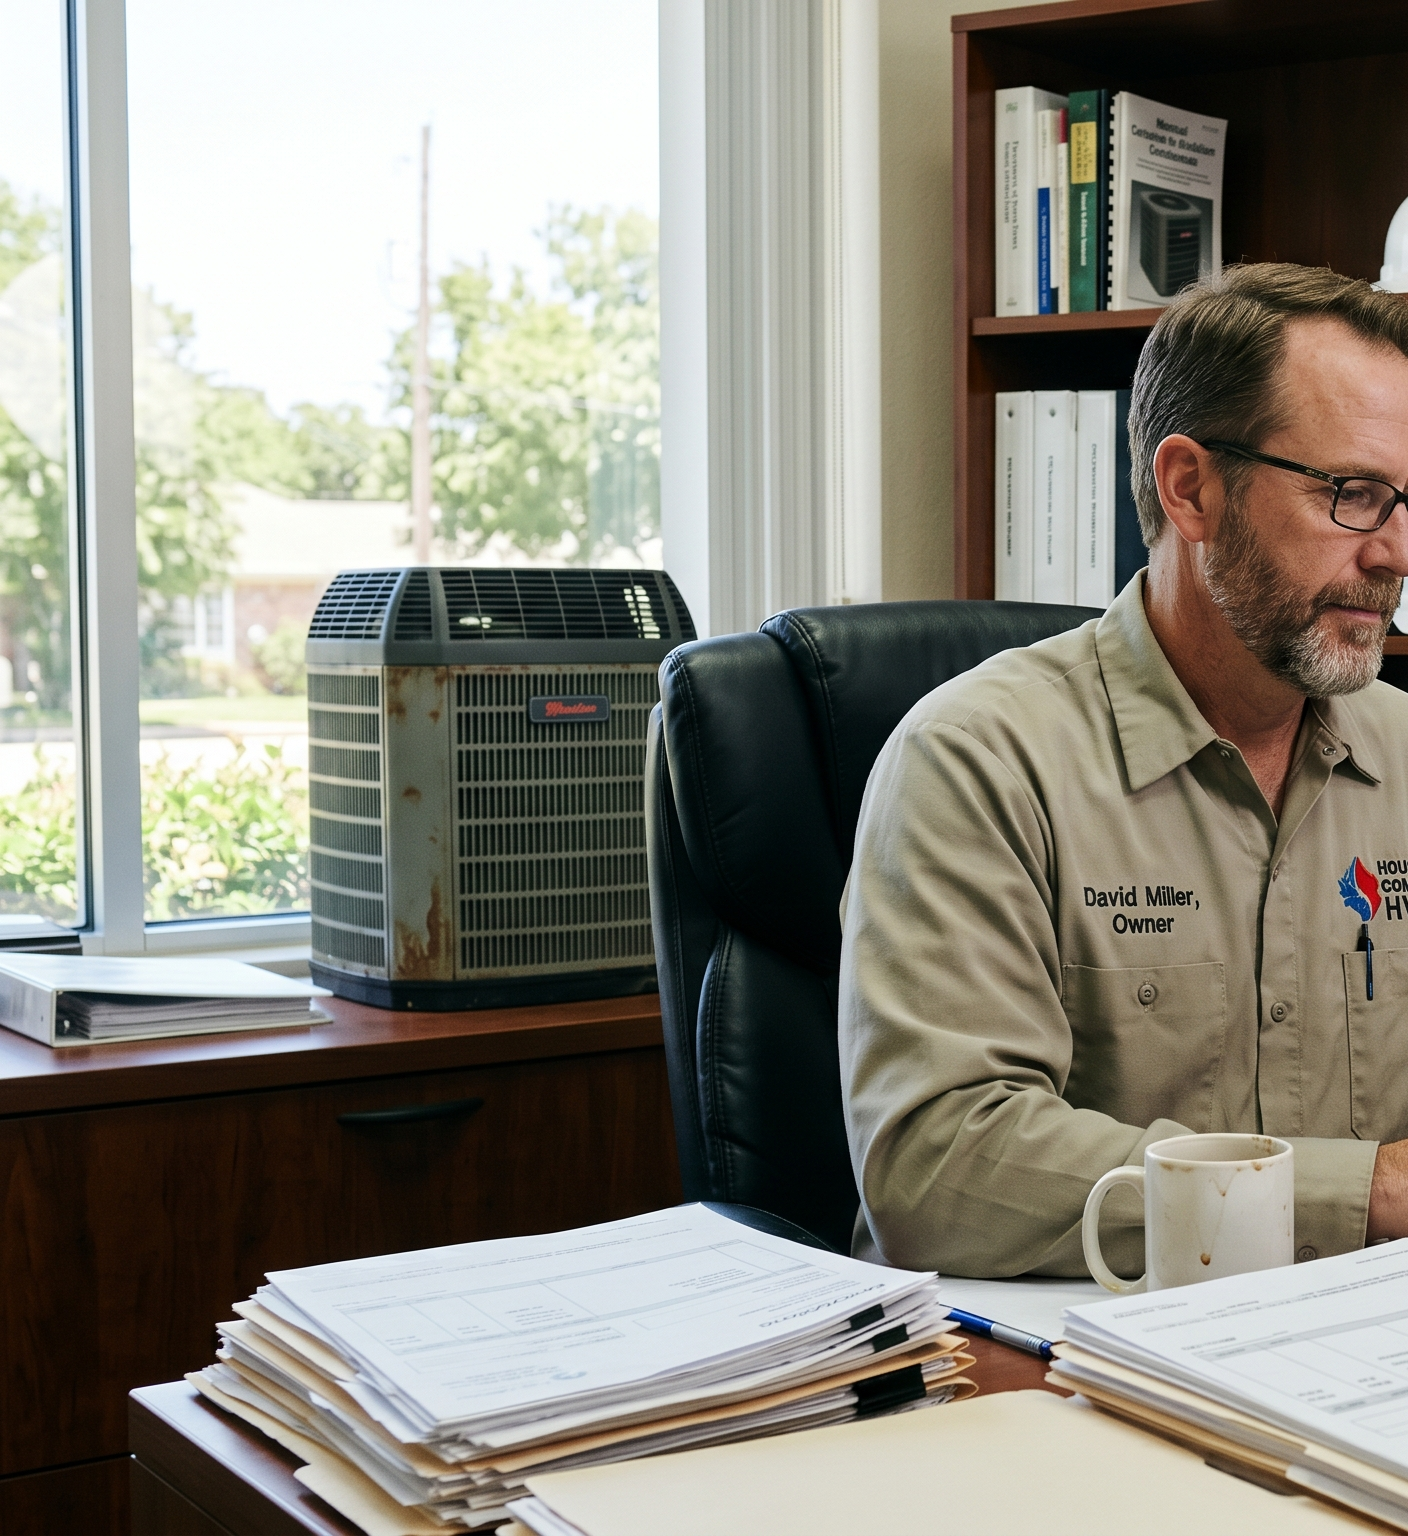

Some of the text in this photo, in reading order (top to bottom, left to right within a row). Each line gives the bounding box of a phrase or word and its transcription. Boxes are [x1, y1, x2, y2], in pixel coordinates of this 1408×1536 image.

[1083, 885, 1200, 911] David Miller,
[1112, 914, 1175, 935] Owner
